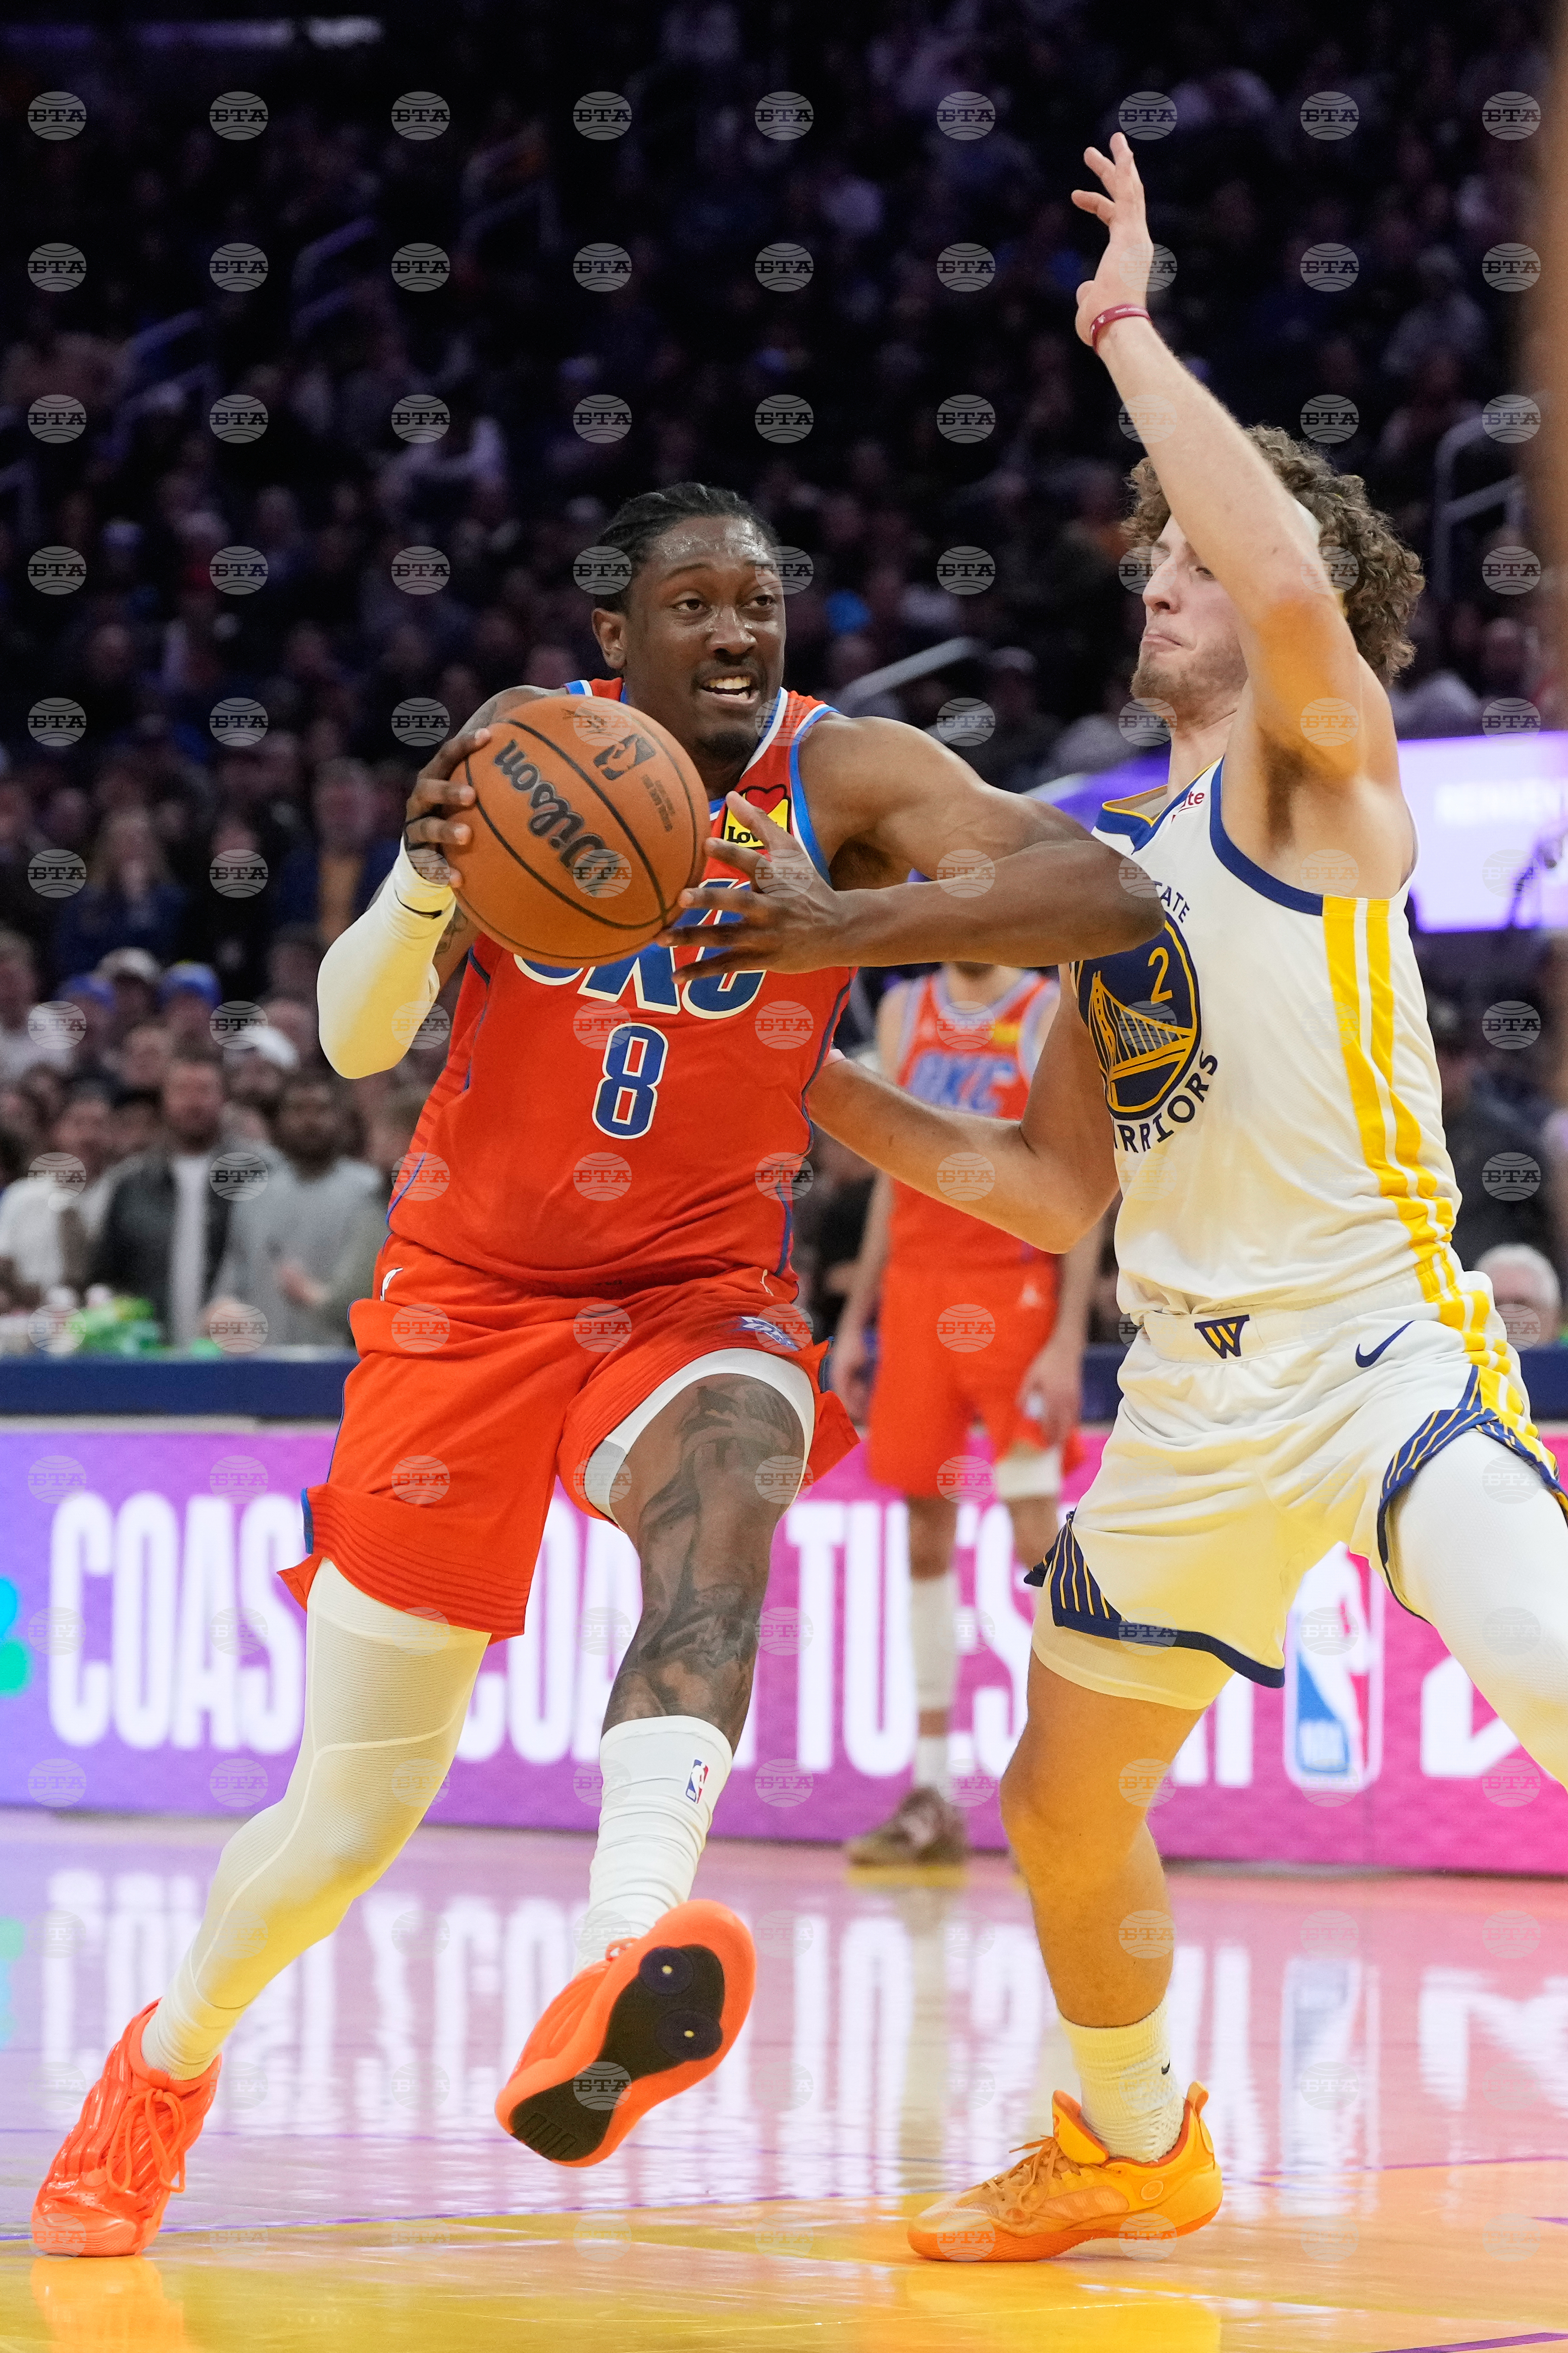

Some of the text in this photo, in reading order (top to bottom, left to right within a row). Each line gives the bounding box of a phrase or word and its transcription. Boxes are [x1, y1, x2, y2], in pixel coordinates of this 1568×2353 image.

[493, 738, 618, 897] Wilson
[514, 878, 767, 1020] KC
[1147, 947, 1173, 1005] 2
[591, 1022, 669, 1140] 8
[1112, 1049, 1218, 1153] RRIORS
[1194, 1314, 1250, 1359] W
[49, 1491, 303, 1754] COAS
